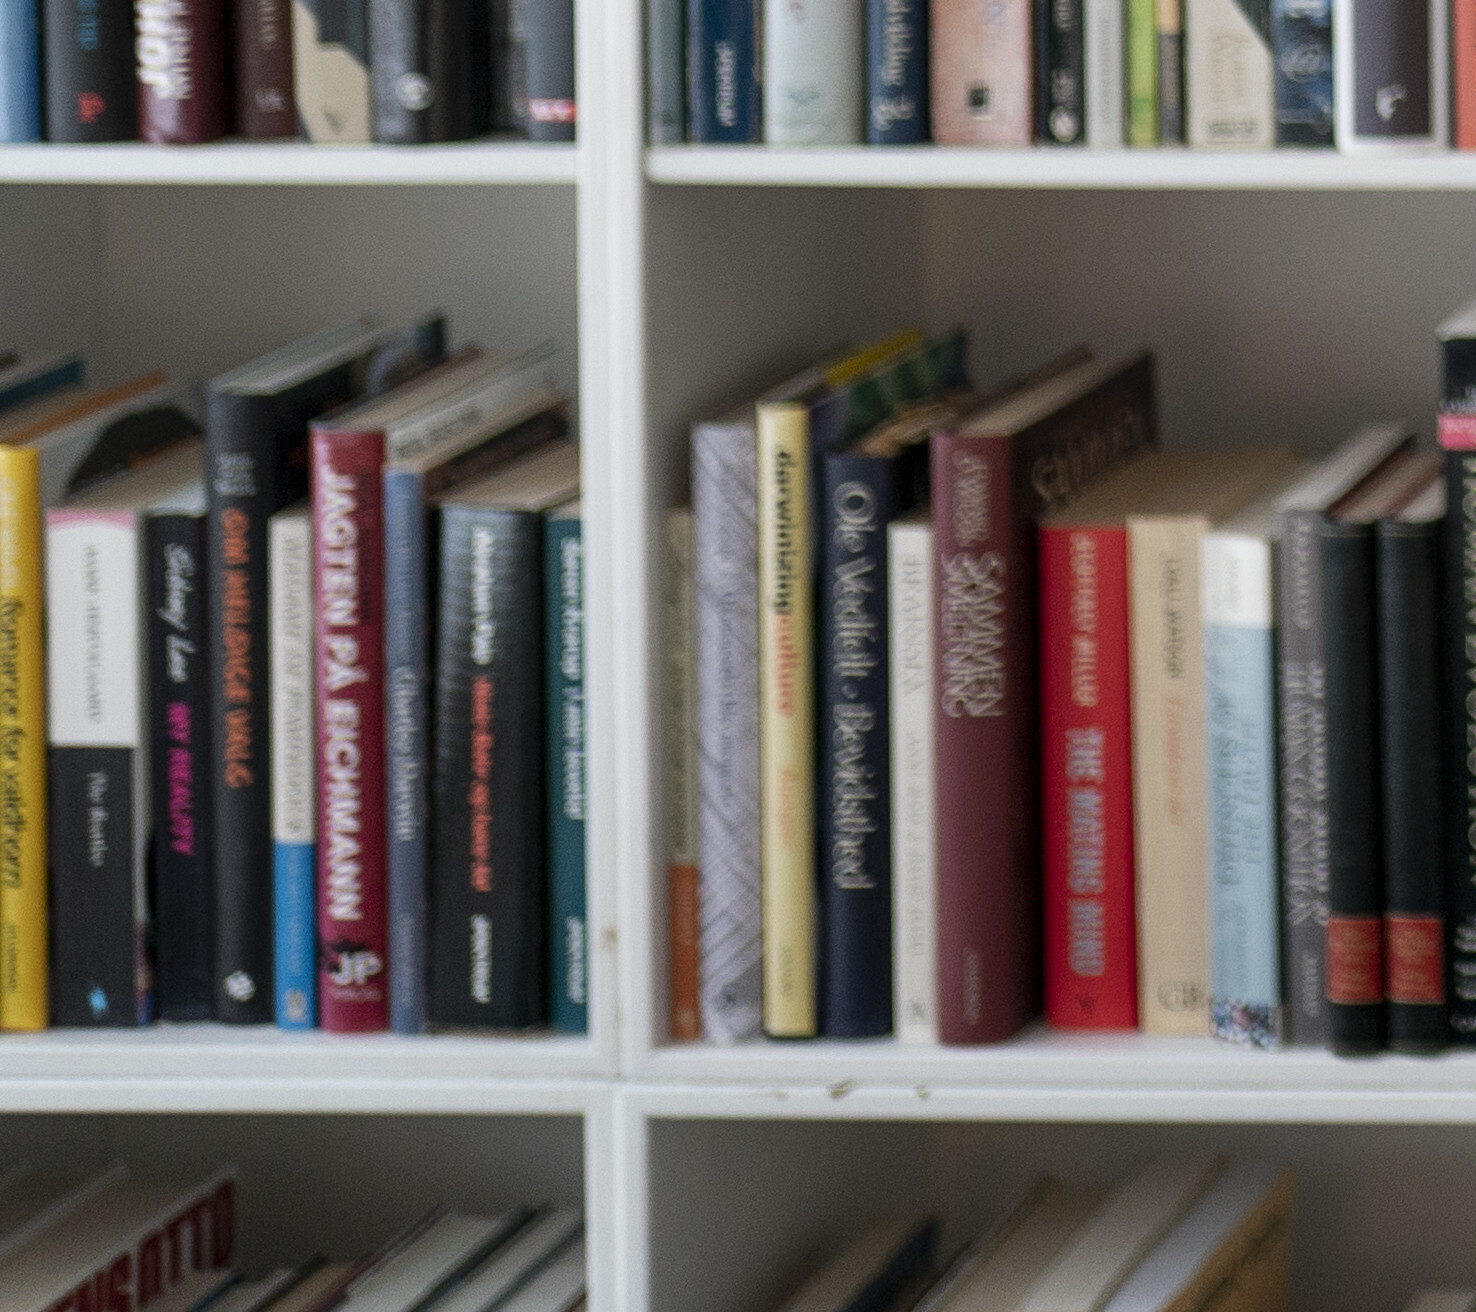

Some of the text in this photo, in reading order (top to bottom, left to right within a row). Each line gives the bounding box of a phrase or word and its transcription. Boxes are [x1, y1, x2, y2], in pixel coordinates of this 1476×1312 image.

[316, 468, 371, 921] JAGTEN PÅ EICHMANN
